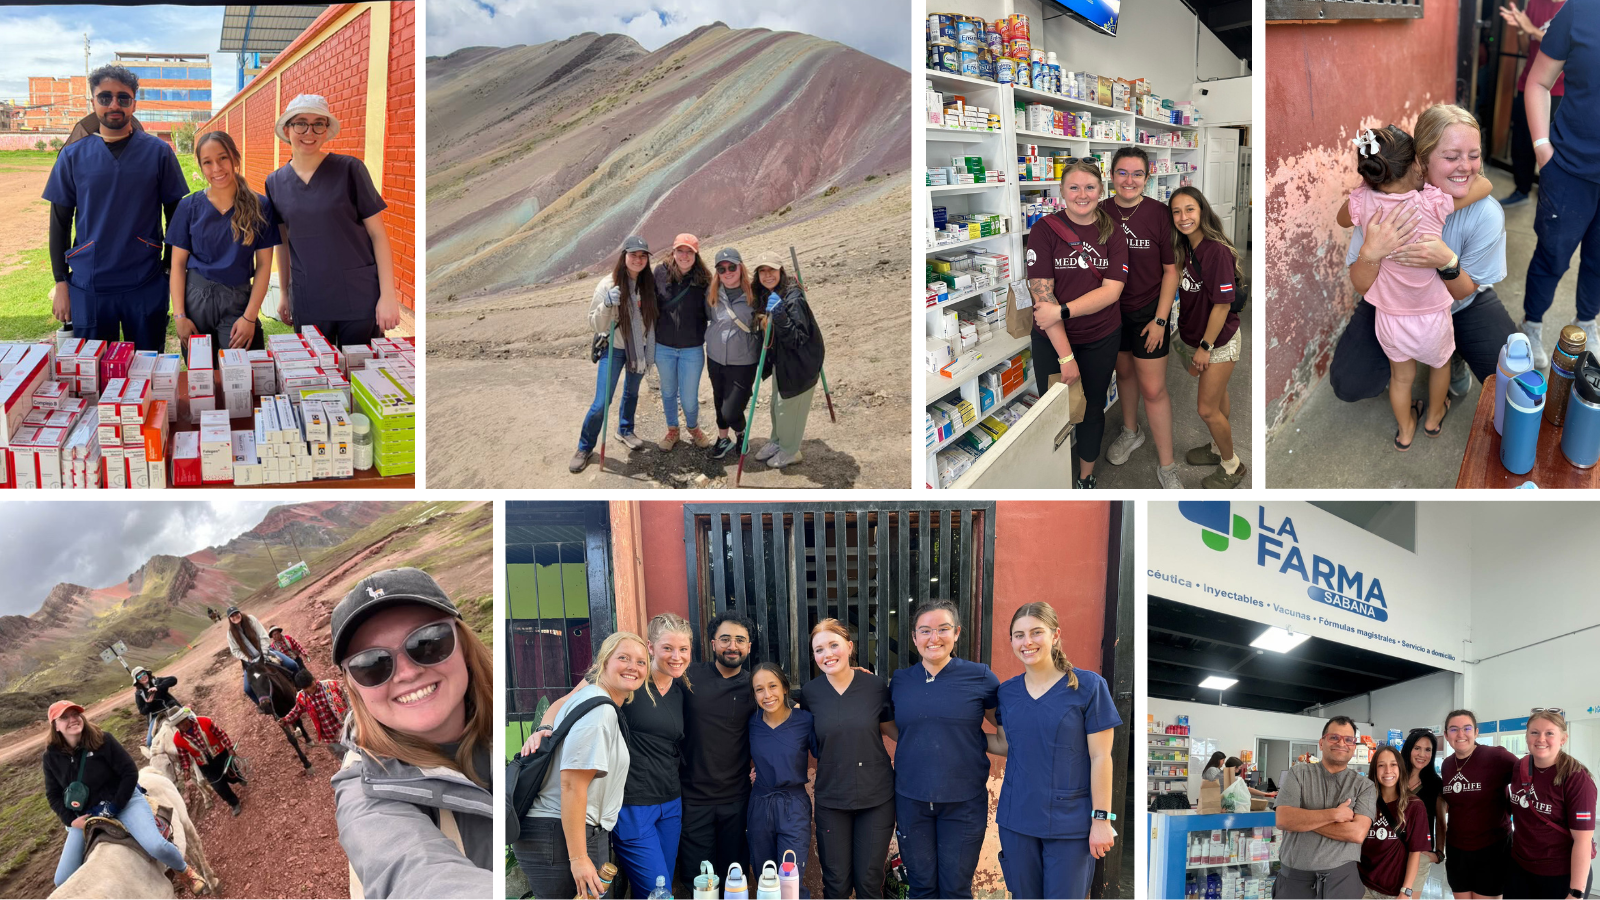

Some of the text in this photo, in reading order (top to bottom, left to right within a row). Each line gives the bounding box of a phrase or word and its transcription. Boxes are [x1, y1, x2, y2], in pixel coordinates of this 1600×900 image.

[1129, 239, 1150, 247] LIFE
[1054, 257, 1109, 267] MED LIF
[1259, 505, 1299, 543] LA
[1257, 533, 1388, 609] FARMA
[1147, 569, 1193, 588] céutica
[1203, 583, 1264, 608] Inyectables
[1273, 603, 1311, 621] Vacunas
[1318, 616, 1355, 633] Fórmulas
[1356, 628, 1396, 645] magistrales
[1401, 639, 1426, 653] Servicio
[1431, 649, 1456, 661] domicilio
[1324, 591, 1376, 618] SABANA
[1463, 782, 1482, 790] LIFE
